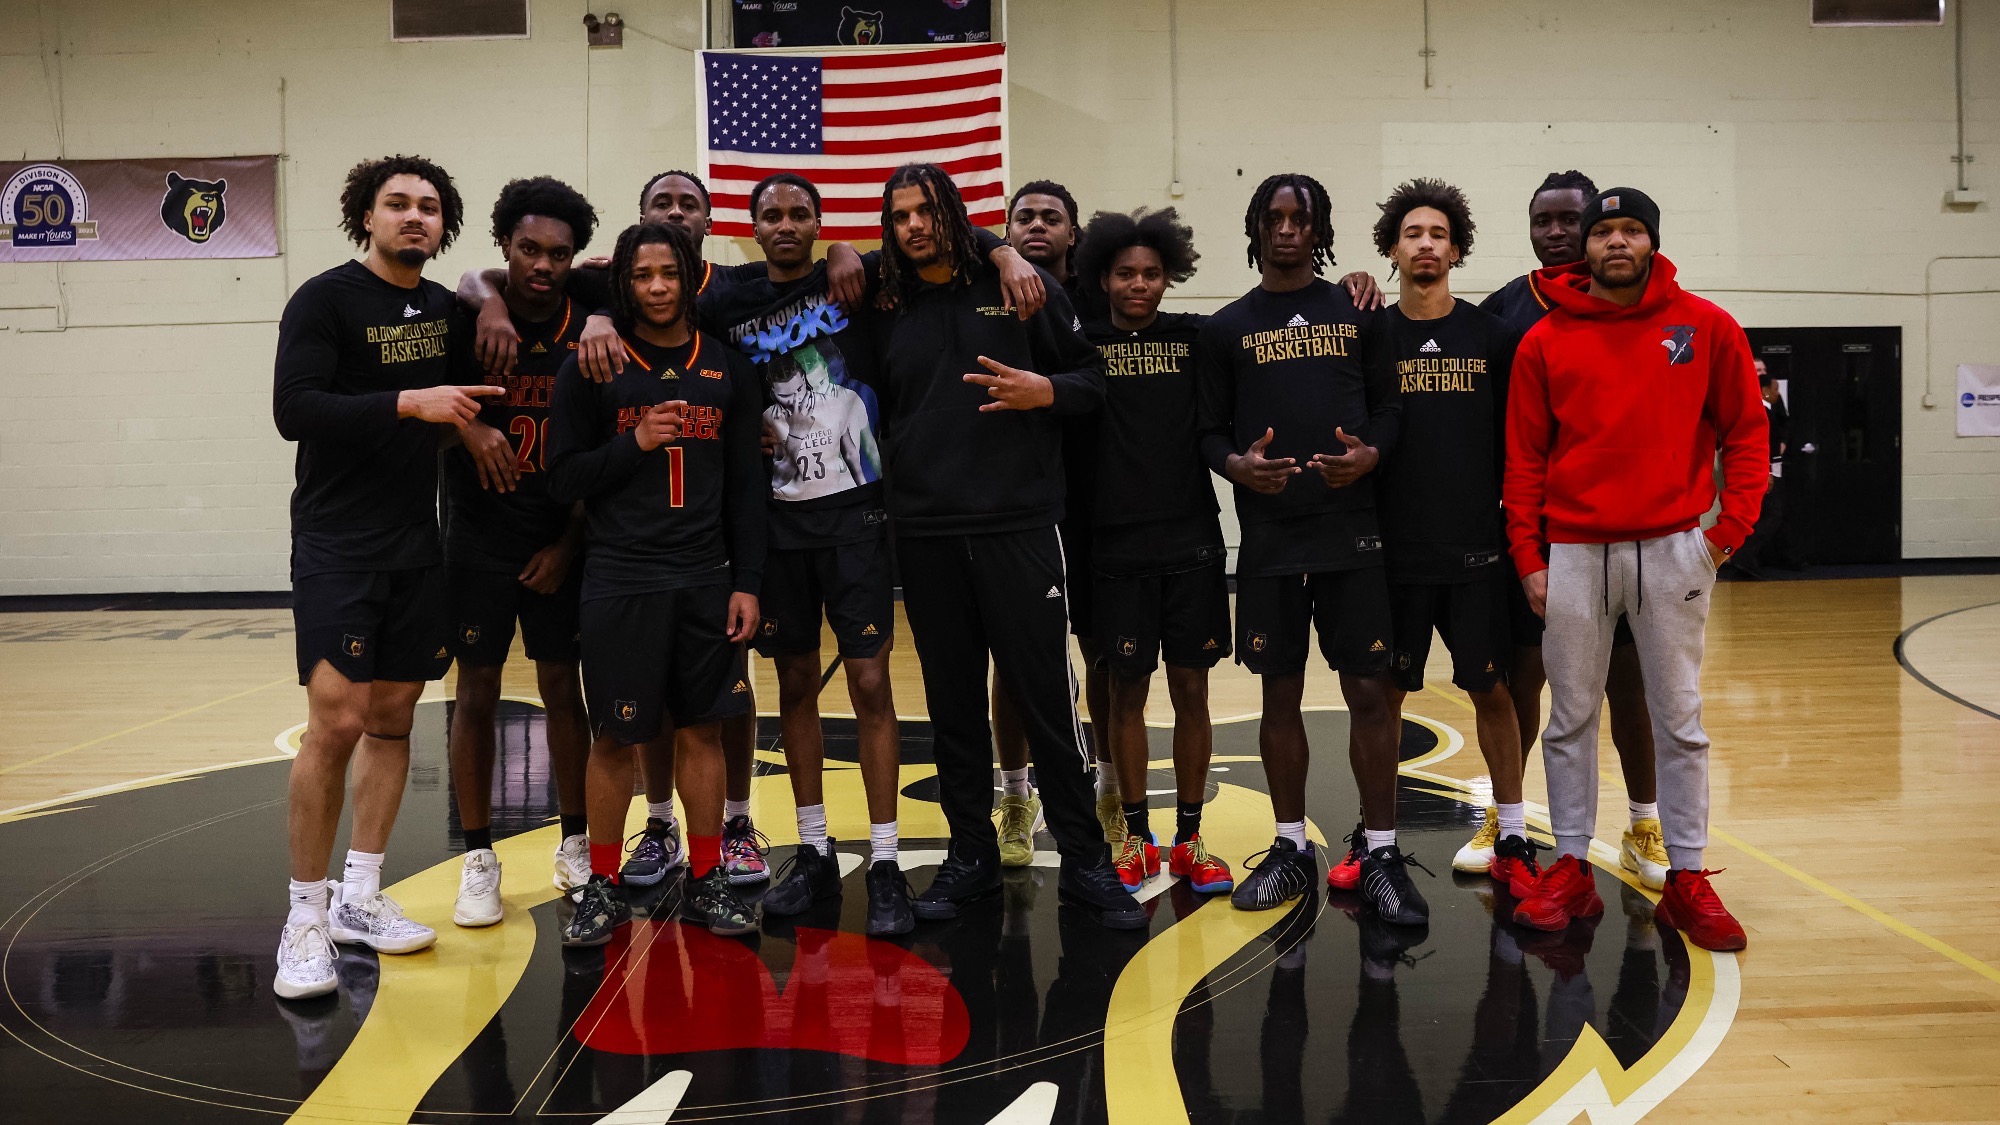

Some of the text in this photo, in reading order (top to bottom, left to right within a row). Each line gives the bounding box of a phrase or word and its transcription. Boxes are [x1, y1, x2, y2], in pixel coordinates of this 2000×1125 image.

[934, 34, 955, 42] MAKE
[19, 170, 60, 185] DIVISION
[33, 184, 54, 192] NCAA
[22, 194, 66, 226] 50
[18, 229, 72, 242] MAKE IT YOURS
[366, 323, 421, 343] BLOOMFIELD
[728, 317, 763, 343] THEY
[740, 303, 849, 365] SMOKE
[1286, 320, 1310, 328] adidas
[1241, 323, 1358, 350] BLOOMFIELD COLLEGE
[381, 337, 446, 364] BASKETBALL
[1143, 342, 1190, 357] COLLEGE
[1255, 336, 1349, 365] BASKETBALL
[1105, 356, 1181, 376] SKETBALL
[1396, 358, 1487, 375] OMFIELD COLLEGE
[1398, 372, 1476, 394] ASKETBALL
[664, 446, 685, 509] 1
[797, 452, 826, 482] 23
